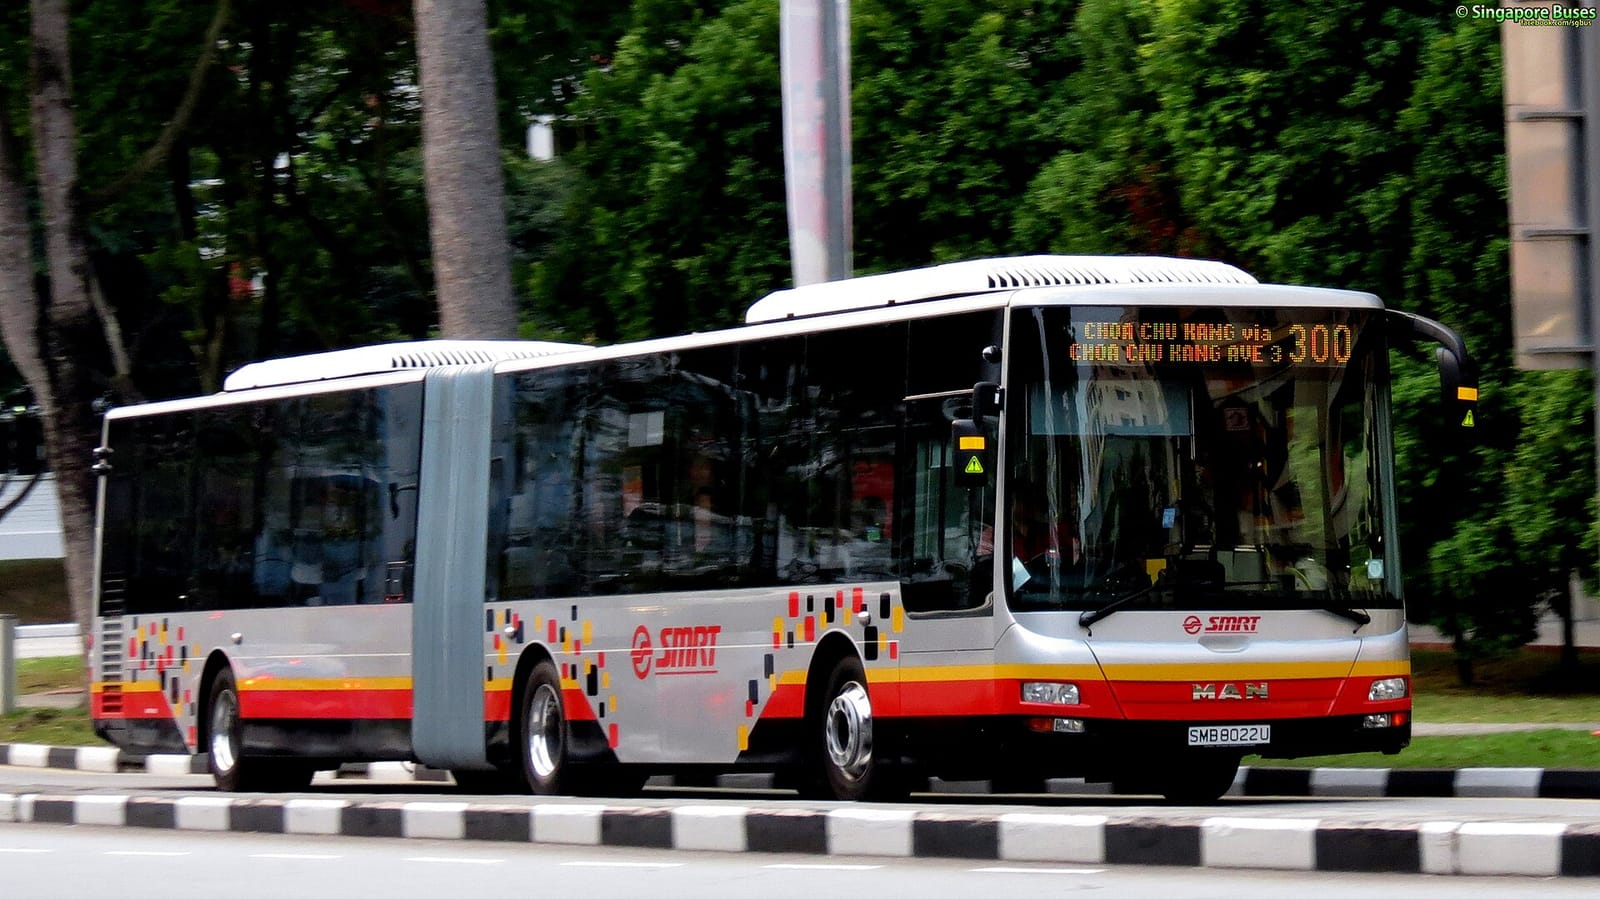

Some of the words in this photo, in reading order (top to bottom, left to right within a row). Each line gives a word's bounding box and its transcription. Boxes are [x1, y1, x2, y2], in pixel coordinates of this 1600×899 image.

[1084, 322, 1133, 340] CHOA
[1140, 322, 1177, 340] CHU
[1184, 322, 1235, 341] KANG
[1241, 324, 1272, 341] via
[1289, 324, 1351, 363] 300
[1070, 344, 1119, 361] CHOA
[1126, 344, 1163, 361] CHU
[1170, 344, 1221, 361] KANG
[1227, 345, 1264, 362] AVE
[1270, 345, 1282, 363] 3
[1205, 616, 1261, 631] SMRT
[656, 625, 721, 668] SMRT
[1192, 682, 1269, 700] MAN
[1189, 727, 1269, 743] SMB8022U
